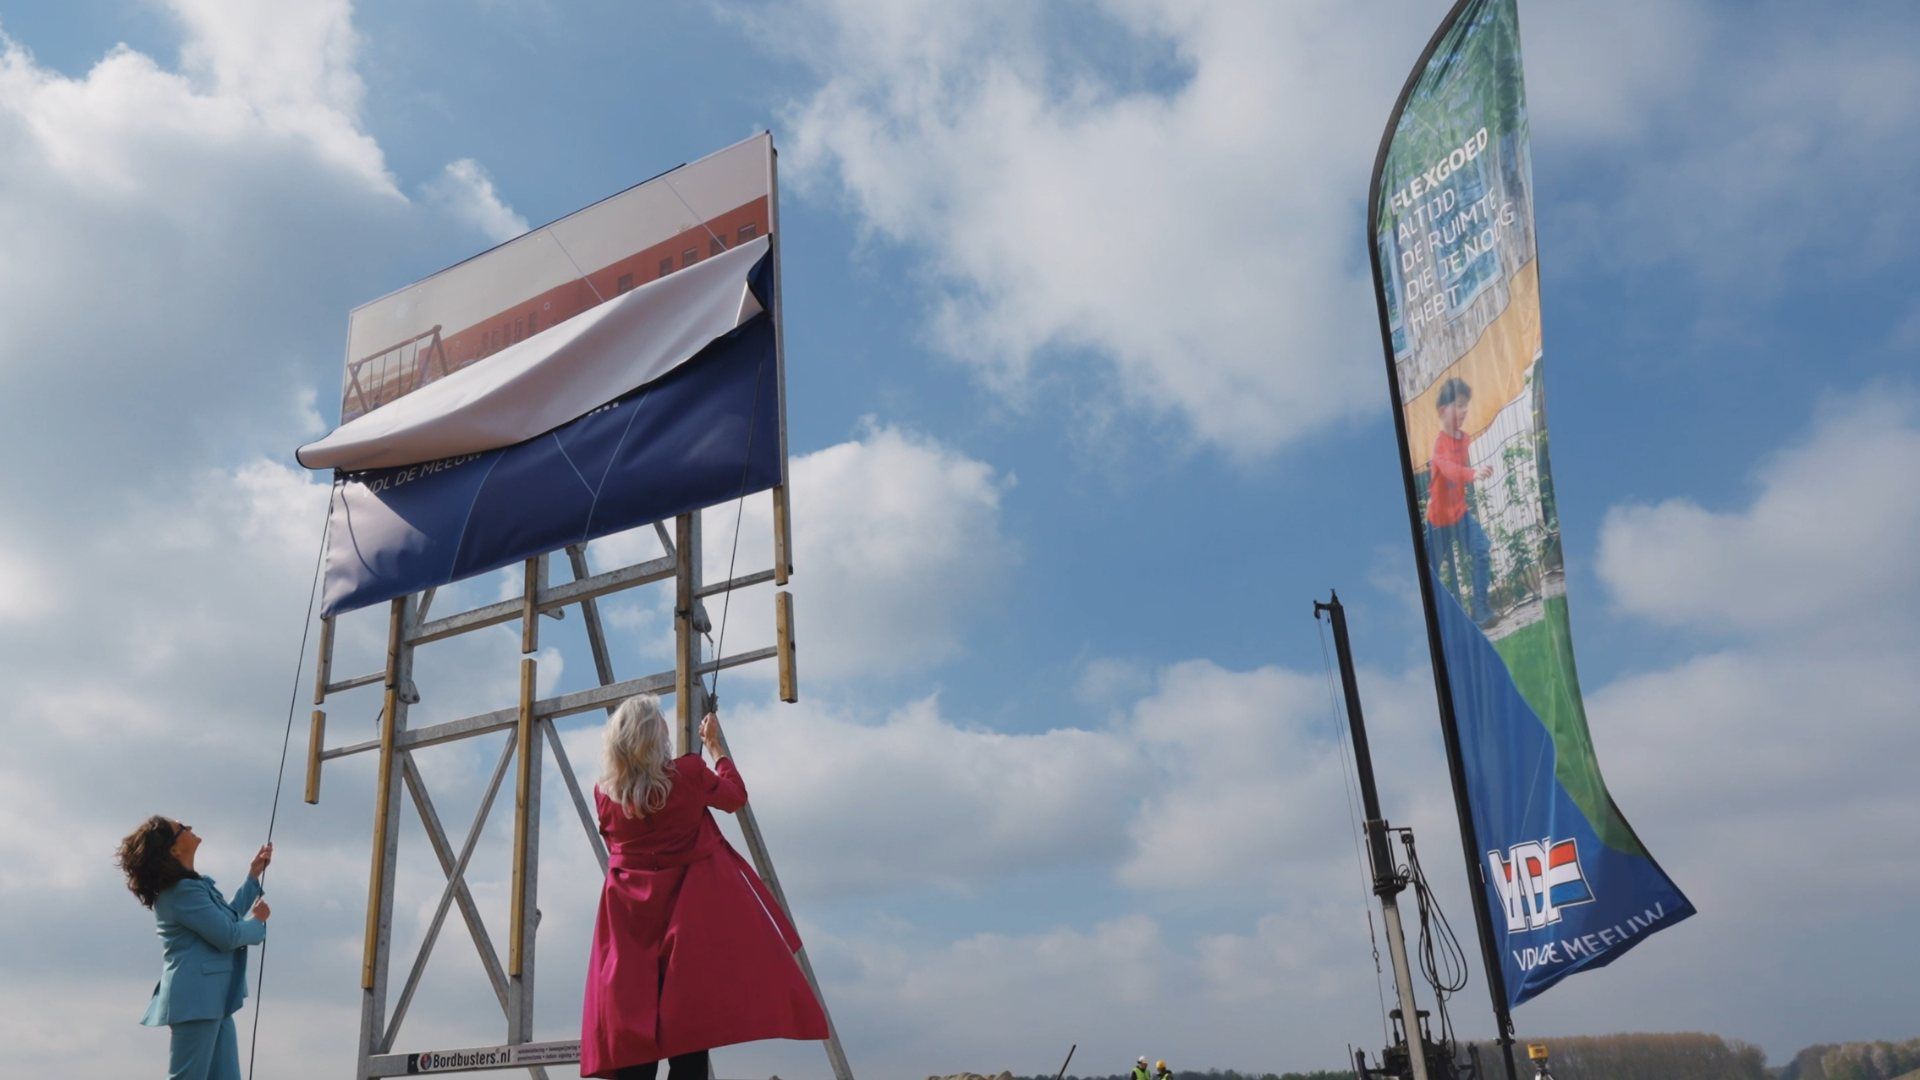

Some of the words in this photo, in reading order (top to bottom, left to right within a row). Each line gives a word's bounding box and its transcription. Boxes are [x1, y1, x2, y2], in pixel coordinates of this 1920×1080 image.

[1390, 127, 1488, 216] FLEXGOED
[1397, 188, 1455, 245] ALTIJD
[1401, 240, 1424, 273] DE
[1428, 186, 1497, 253] RUIMTE
[1405, 266, 1434, 302] DIE
[1439, 250, 1463, 281] JE
[1410, 284, 1460, 336] HEBT
[395, 466, 417, 486] DE
[1487, 834, 1562, 934] VDL
[1538, 942, 1564, 965] DE
[1561, 901, 1665, 960] MEEUW
[433, 1049, 511, 1068] Bordbusters.nl
